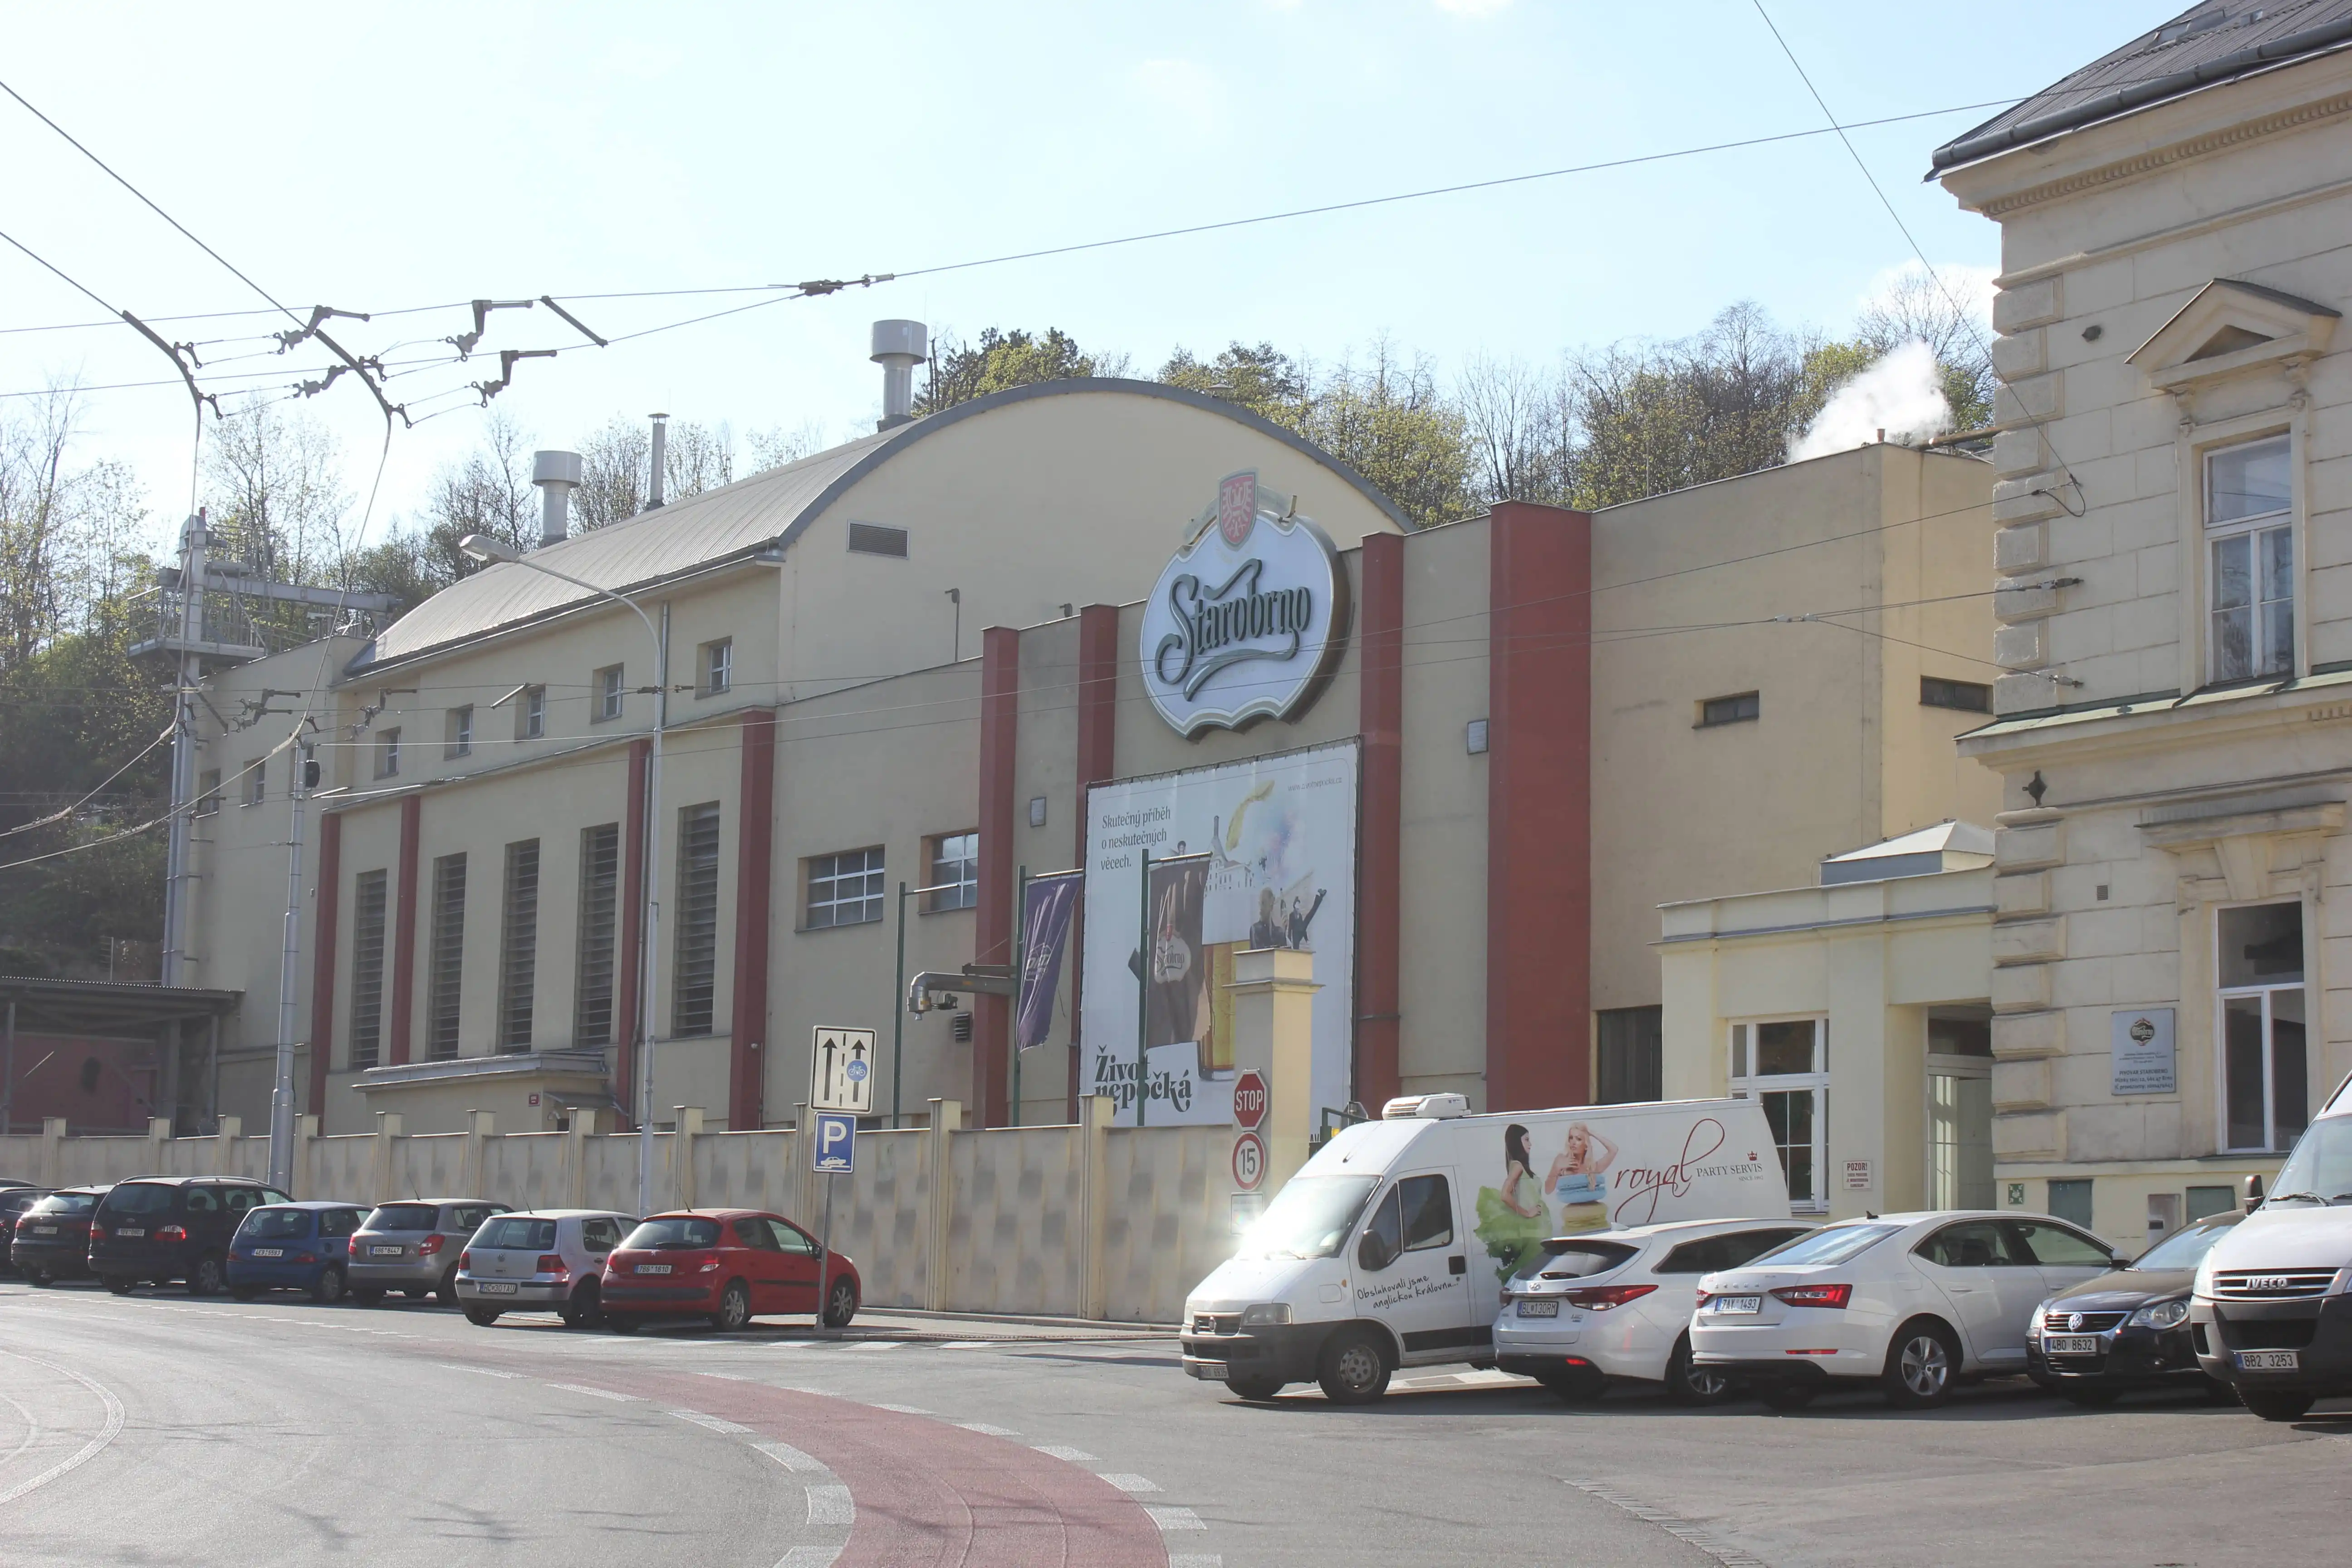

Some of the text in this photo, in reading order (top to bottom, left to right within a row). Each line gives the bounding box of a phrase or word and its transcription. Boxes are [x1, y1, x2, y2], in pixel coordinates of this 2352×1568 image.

[1155, 558, 1312, 702] Starobrno
[1102, 805, 1171, 828] Skutečný příběh
[1101, 828, 1167, 849] o neskutečných
[1101, 854, 1132, 870] věcech.
[1235, 1090, 1263, 1112] STOP
[823, 1120, 847, 1154] P
[1241, 1148, 1256, 1175] 15
[1614, 1118, 1725, 1223] royal
[1696, 1163, 1762, 1177] PARTY SERVIS
[1847, 1162, 1867, 1171] POZOR!
[1357, 1275, 1429, 1300] Obsluhovali jsme
[2246, 1277, 2288, 1289] IVECO
[1373, 1290, 1413, 1309] anglickou
[1522, 1303, 1556, 1314] BL 130RM
[1740, 1298, 1757, 1309] 1493
[2072, 1339, 2092, 1351] 8632
[2244, 1354, 2293, 1367] 8B2 3253
